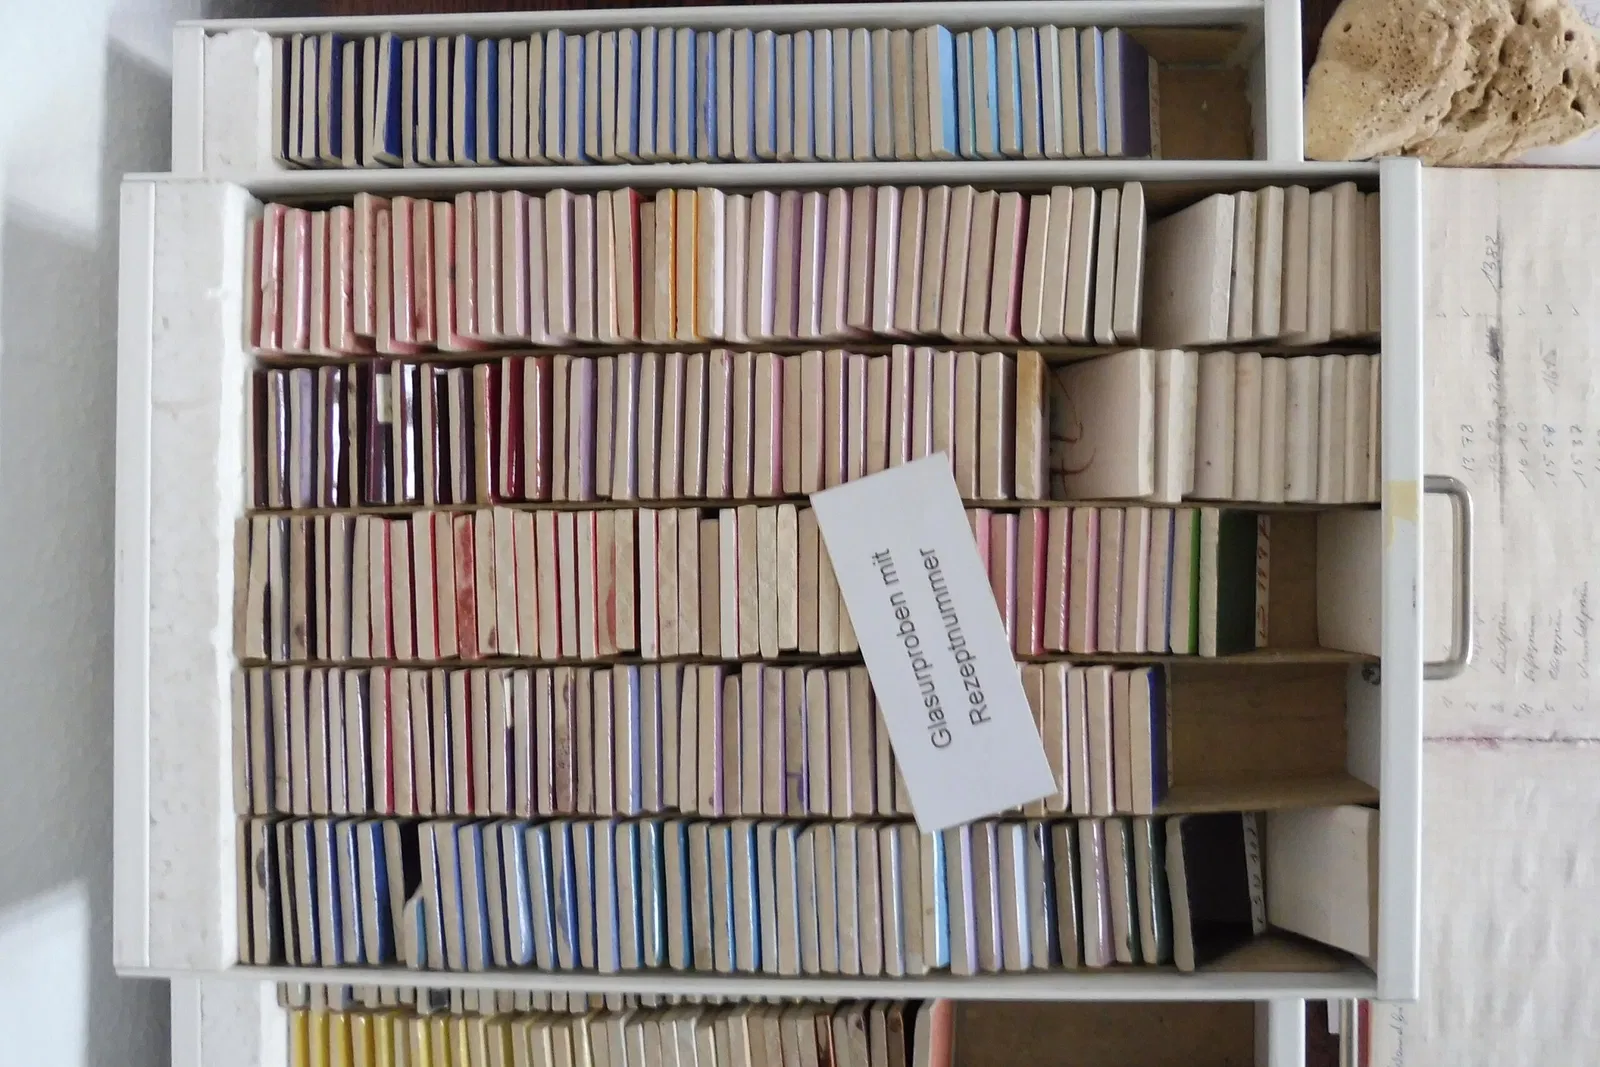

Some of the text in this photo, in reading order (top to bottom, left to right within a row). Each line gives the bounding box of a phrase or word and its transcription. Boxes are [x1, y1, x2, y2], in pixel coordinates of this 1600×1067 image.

[870, 547, 952, 749] Glasurproben mit
[919, 547, 992, 726] Rezeptnummer
